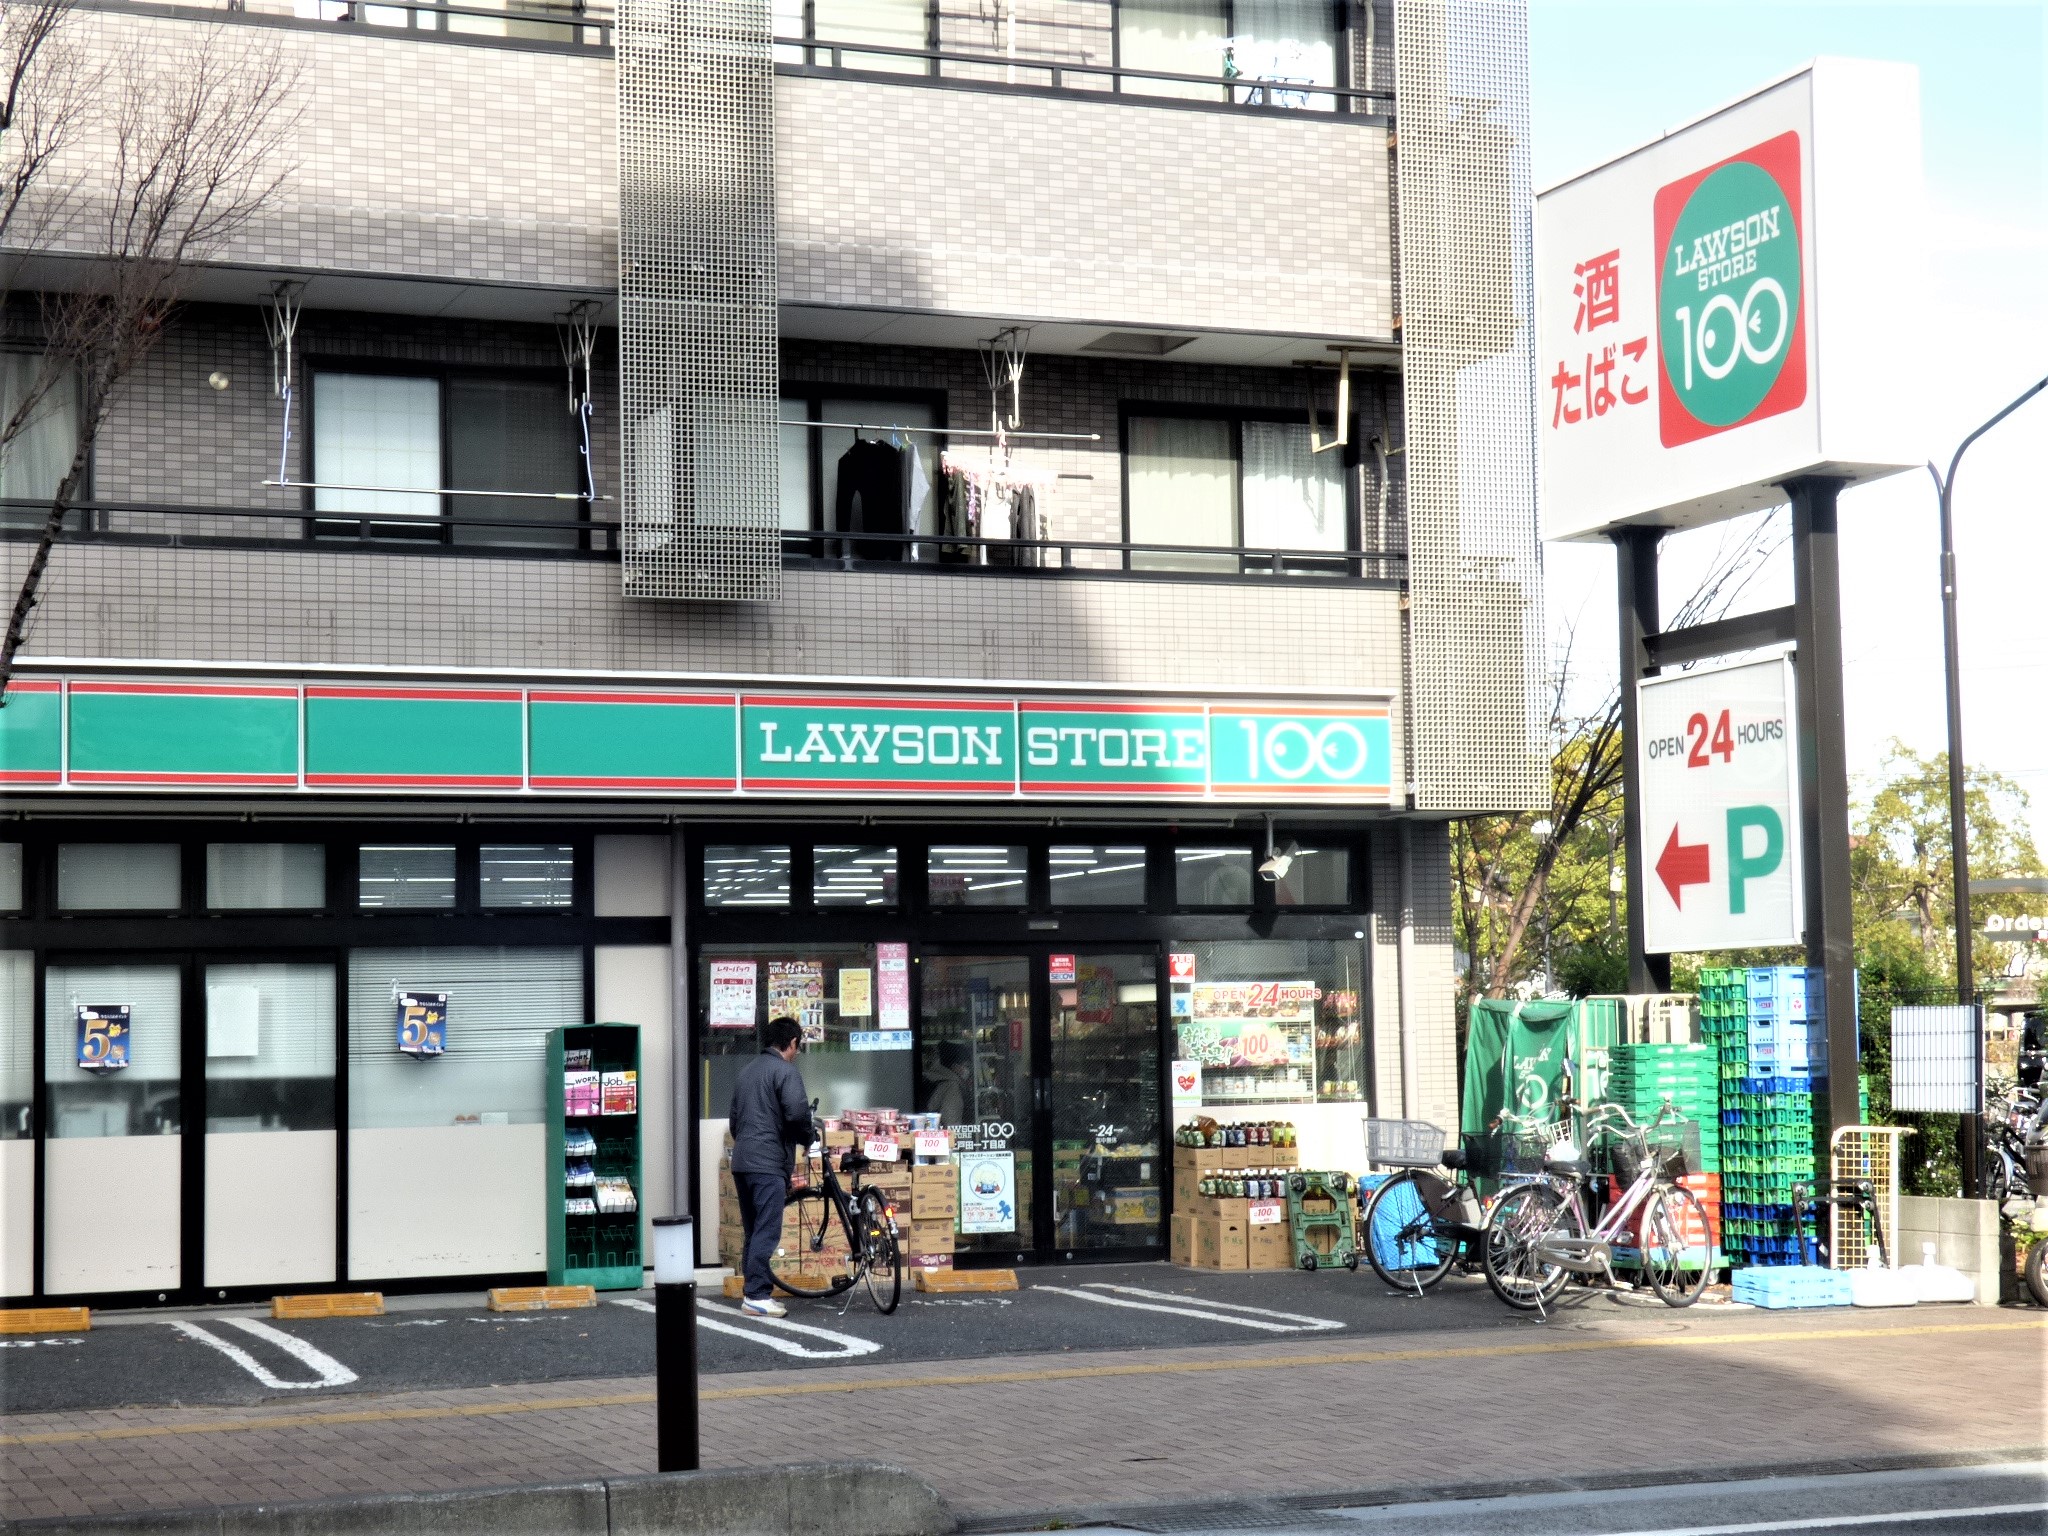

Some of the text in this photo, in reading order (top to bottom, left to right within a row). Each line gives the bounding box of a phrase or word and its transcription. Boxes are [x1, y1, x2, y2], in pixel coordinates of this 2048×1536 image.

[1675, 205, 1780, 277] LAWSON
[1697, 249, 1757, 291] STORE
[1572, 248, 1621, 336] 酒
[1675, 277, 1788, 391] 100
[1551, 336, 1648, 430] たばこ
[759, 719, 1369, 781] LAWSON STORE 100
[1649, 709, 1783, 768] OPEN 24 HOURS
[1726, 804, 1784, 915] P
[1213, 983, 1322, 1007] OPEN 24 HOURS
[83, 1020, 111, 1060] 5
[402, 1007, 428, 1046] 5
[1241, 1033, 1269, 1056] 100
[575, 1075, 598, 1084] WORK
[604, 1076, 623, 1087] Job
[873, 1143, 889, 1153] 100
[925, 1139, 940, 1148] 100
[983, 1122, 1014, 1138] 100
[1098, 1124, 1113, 1137] 24
[1257, 1208, 1273, 1217] 100
